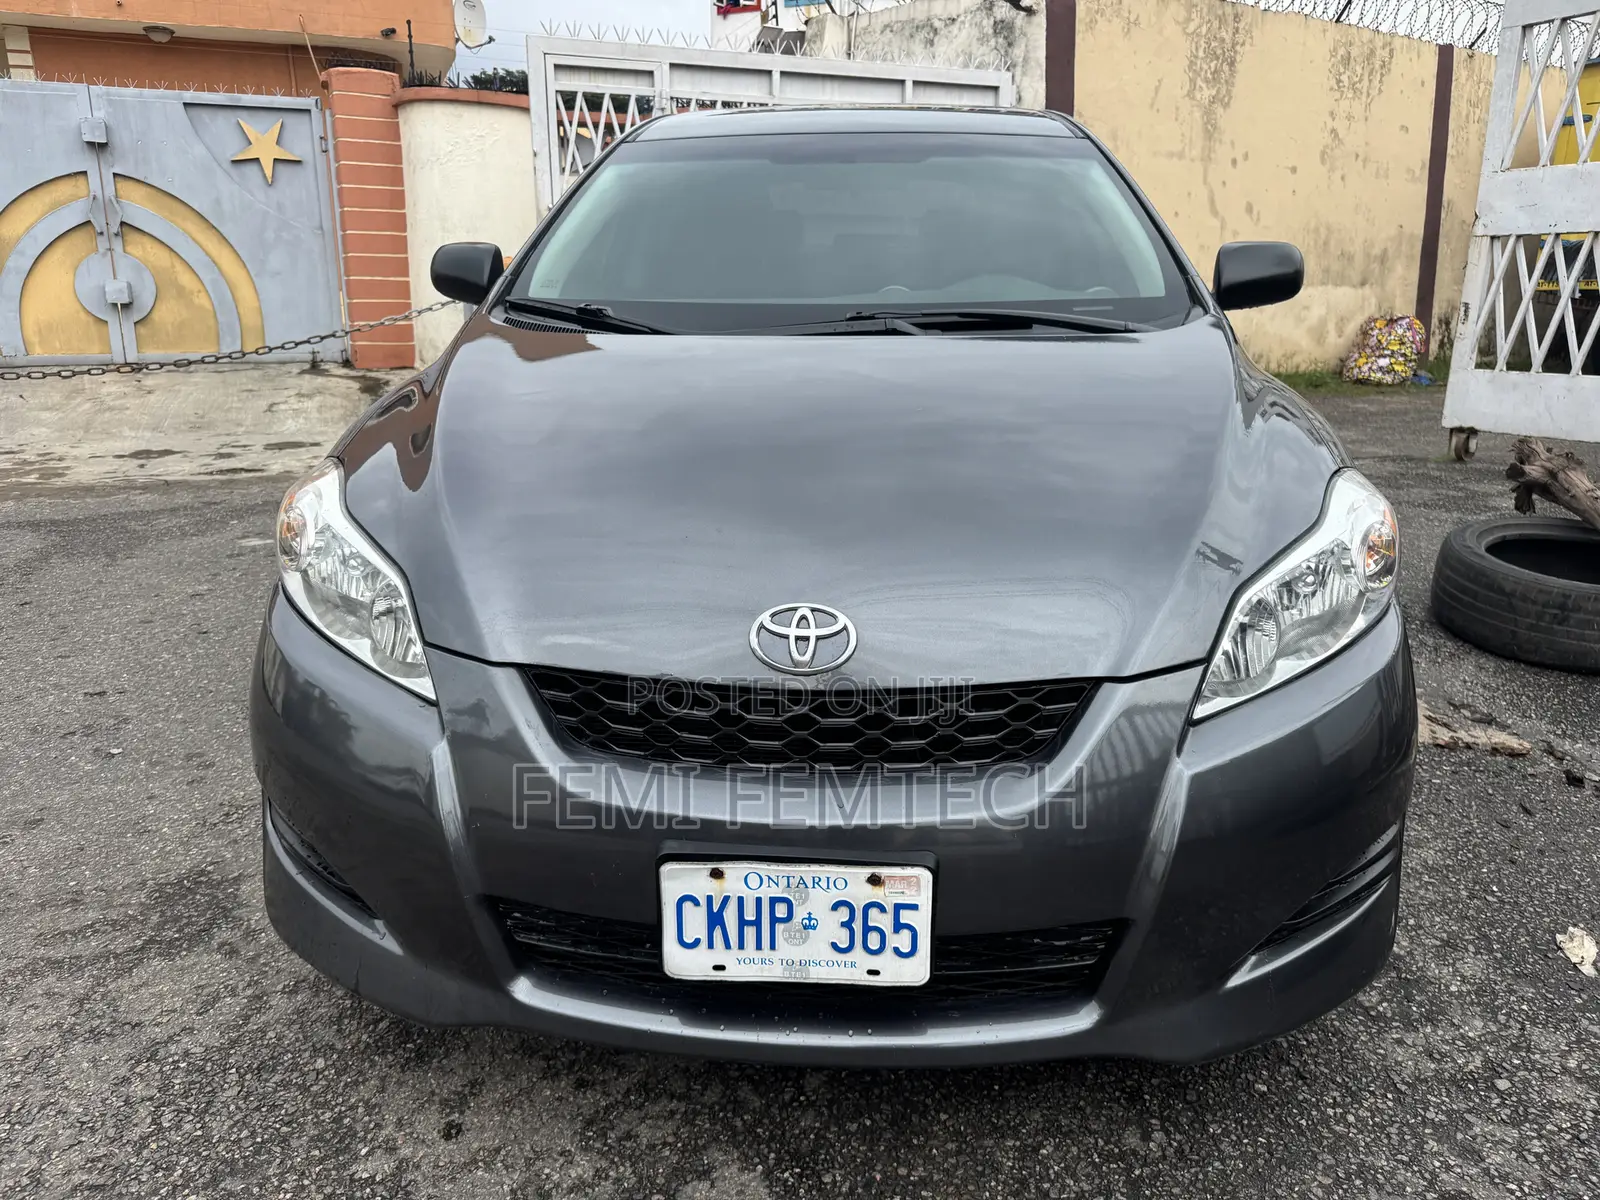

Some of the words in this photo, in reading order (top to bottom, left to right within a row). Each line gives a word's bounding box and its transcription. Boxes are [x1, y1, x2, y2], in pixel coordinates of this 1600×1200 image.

[743, 871, 848, 893] ONTARIO
[675, 893, 794, 950] CKHP
[830, 900, 919, 959] 365
[736, 957, 774, 966] YOURS
[778, 958, 795, 967] TO
[799, 958, 857, 969] DISCOVER
